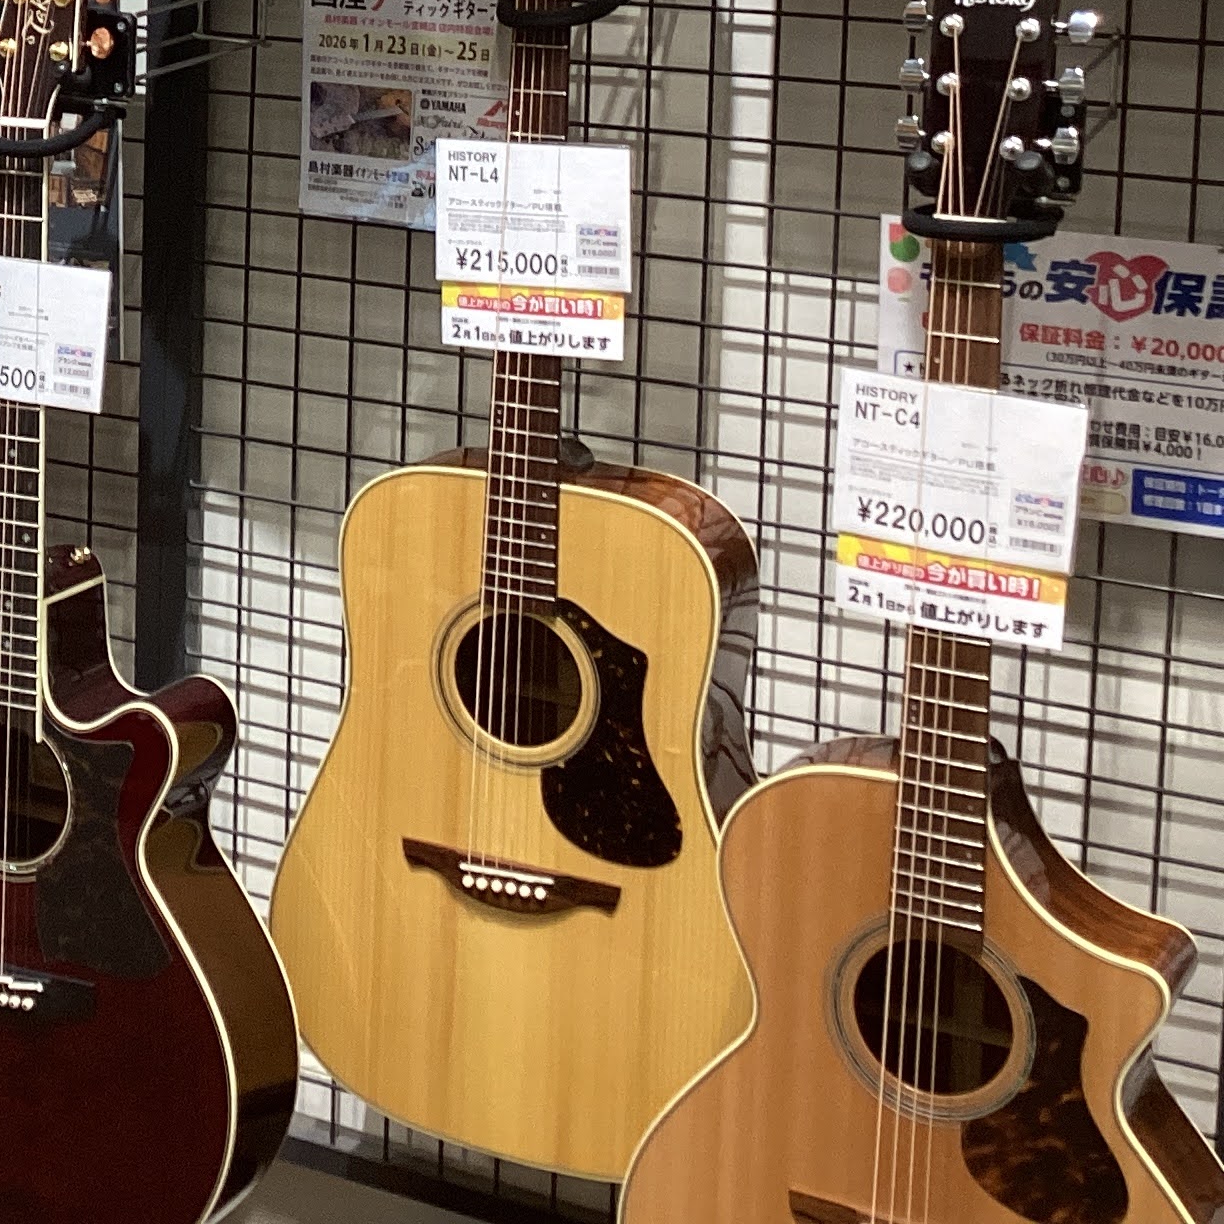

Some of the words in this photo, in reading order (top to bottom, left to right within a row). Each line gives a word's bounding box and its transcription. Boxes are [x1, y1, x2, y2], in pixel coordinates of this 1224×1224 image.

[432, 100, 467, 114] YAMAHA
[448, 150, 497, 164] HISTORY
[448, 165, 499, 184] NT-L4
[456, 247, 558, 276] ¥215,000
[855, 383, 917, 404] HISTORY
[855, 400, 920, 429] NT-C4
[857, 495, 985, 545] ¥220,000
